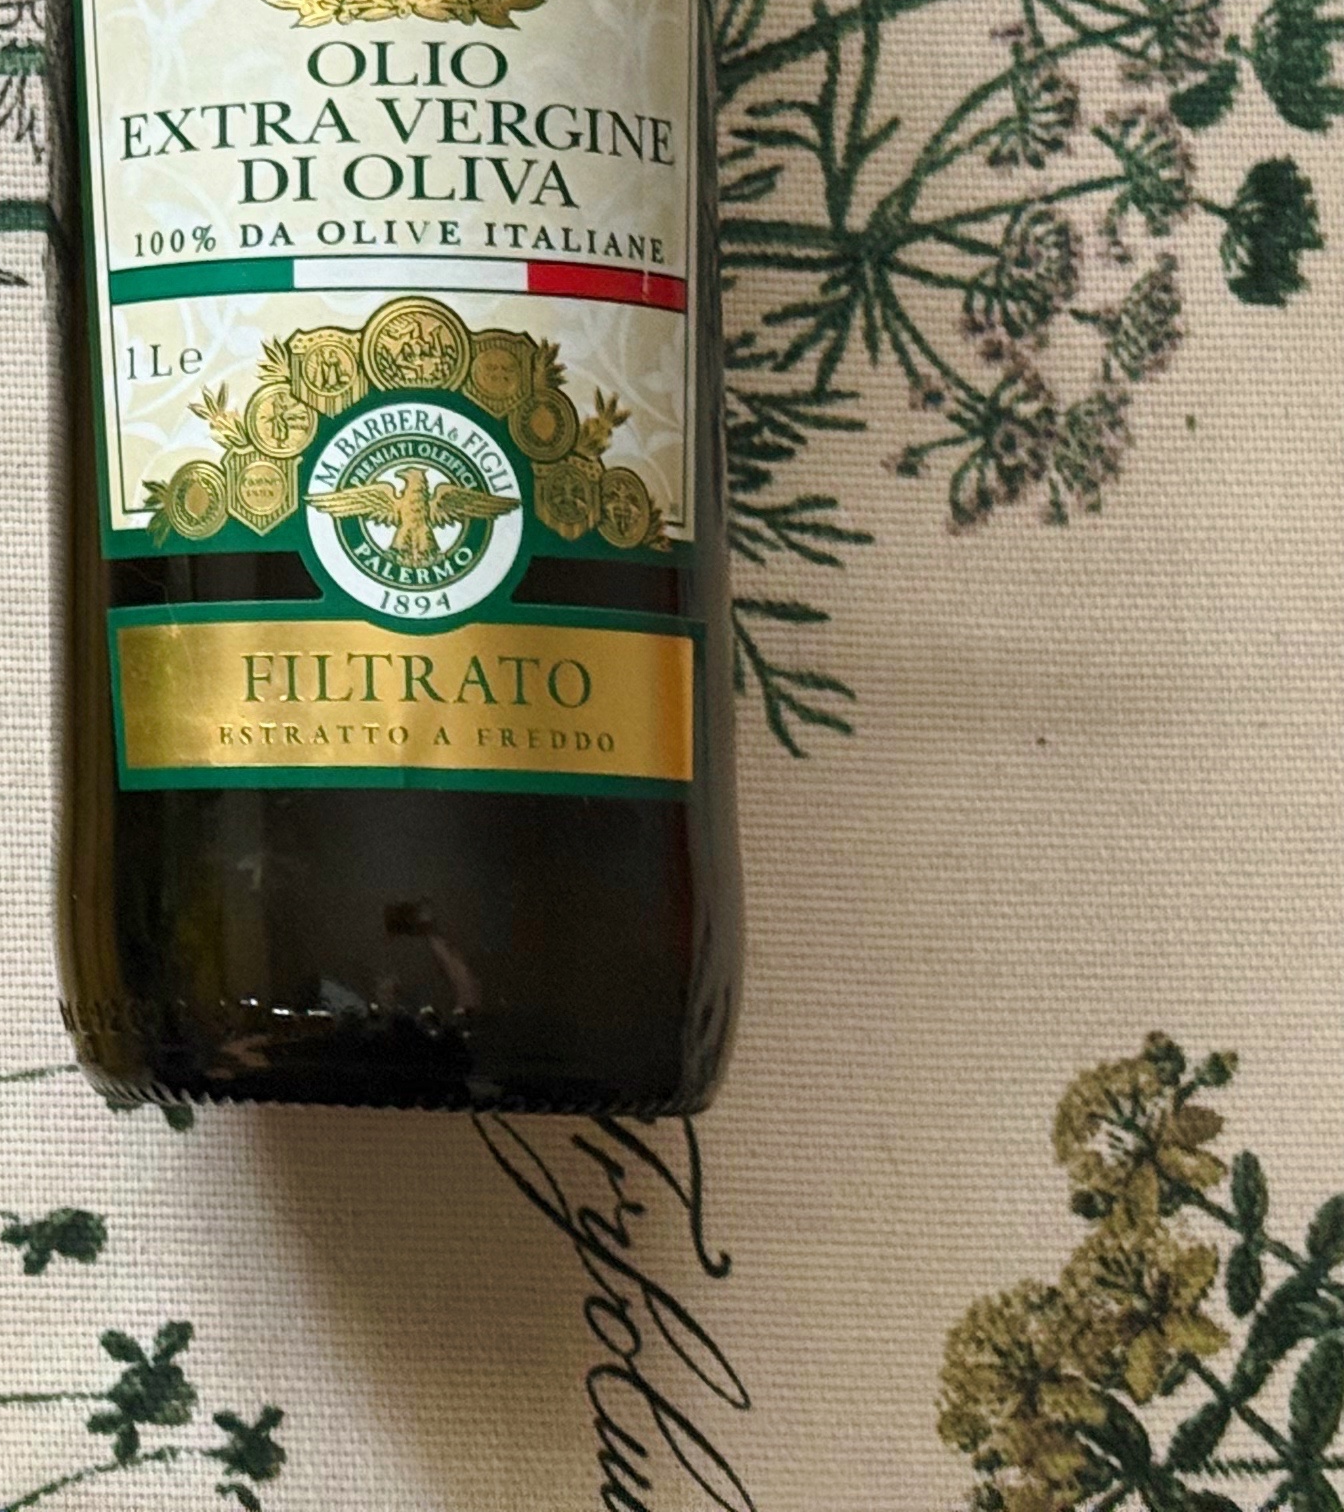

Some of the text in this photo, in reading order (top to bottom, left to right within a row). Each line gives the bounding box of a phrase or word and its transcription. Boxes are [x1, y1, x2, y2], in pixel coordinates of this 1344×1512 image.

[307, 40, 509, 89] OLIO
[119, 98, 676, 166] EXTRA VERGINE
[238, 155, 580, 208] DI OLIVA
[133, 220, 666, 265] 100% DA OLIVE ITALIANE
[333, 409, 445, 460] BARBERA
[462, 430, 513, 493] FIGLI
[350, 442, 478, 490] PREMIATI OLEIFICI
[353, 541, 473, 584] PALERMO
[379, 591, 452, 616] 1894
[241, 651, 593, 710] FILTRATO
[218, 723, 616, 753] ESTRATTO A FREDDO
